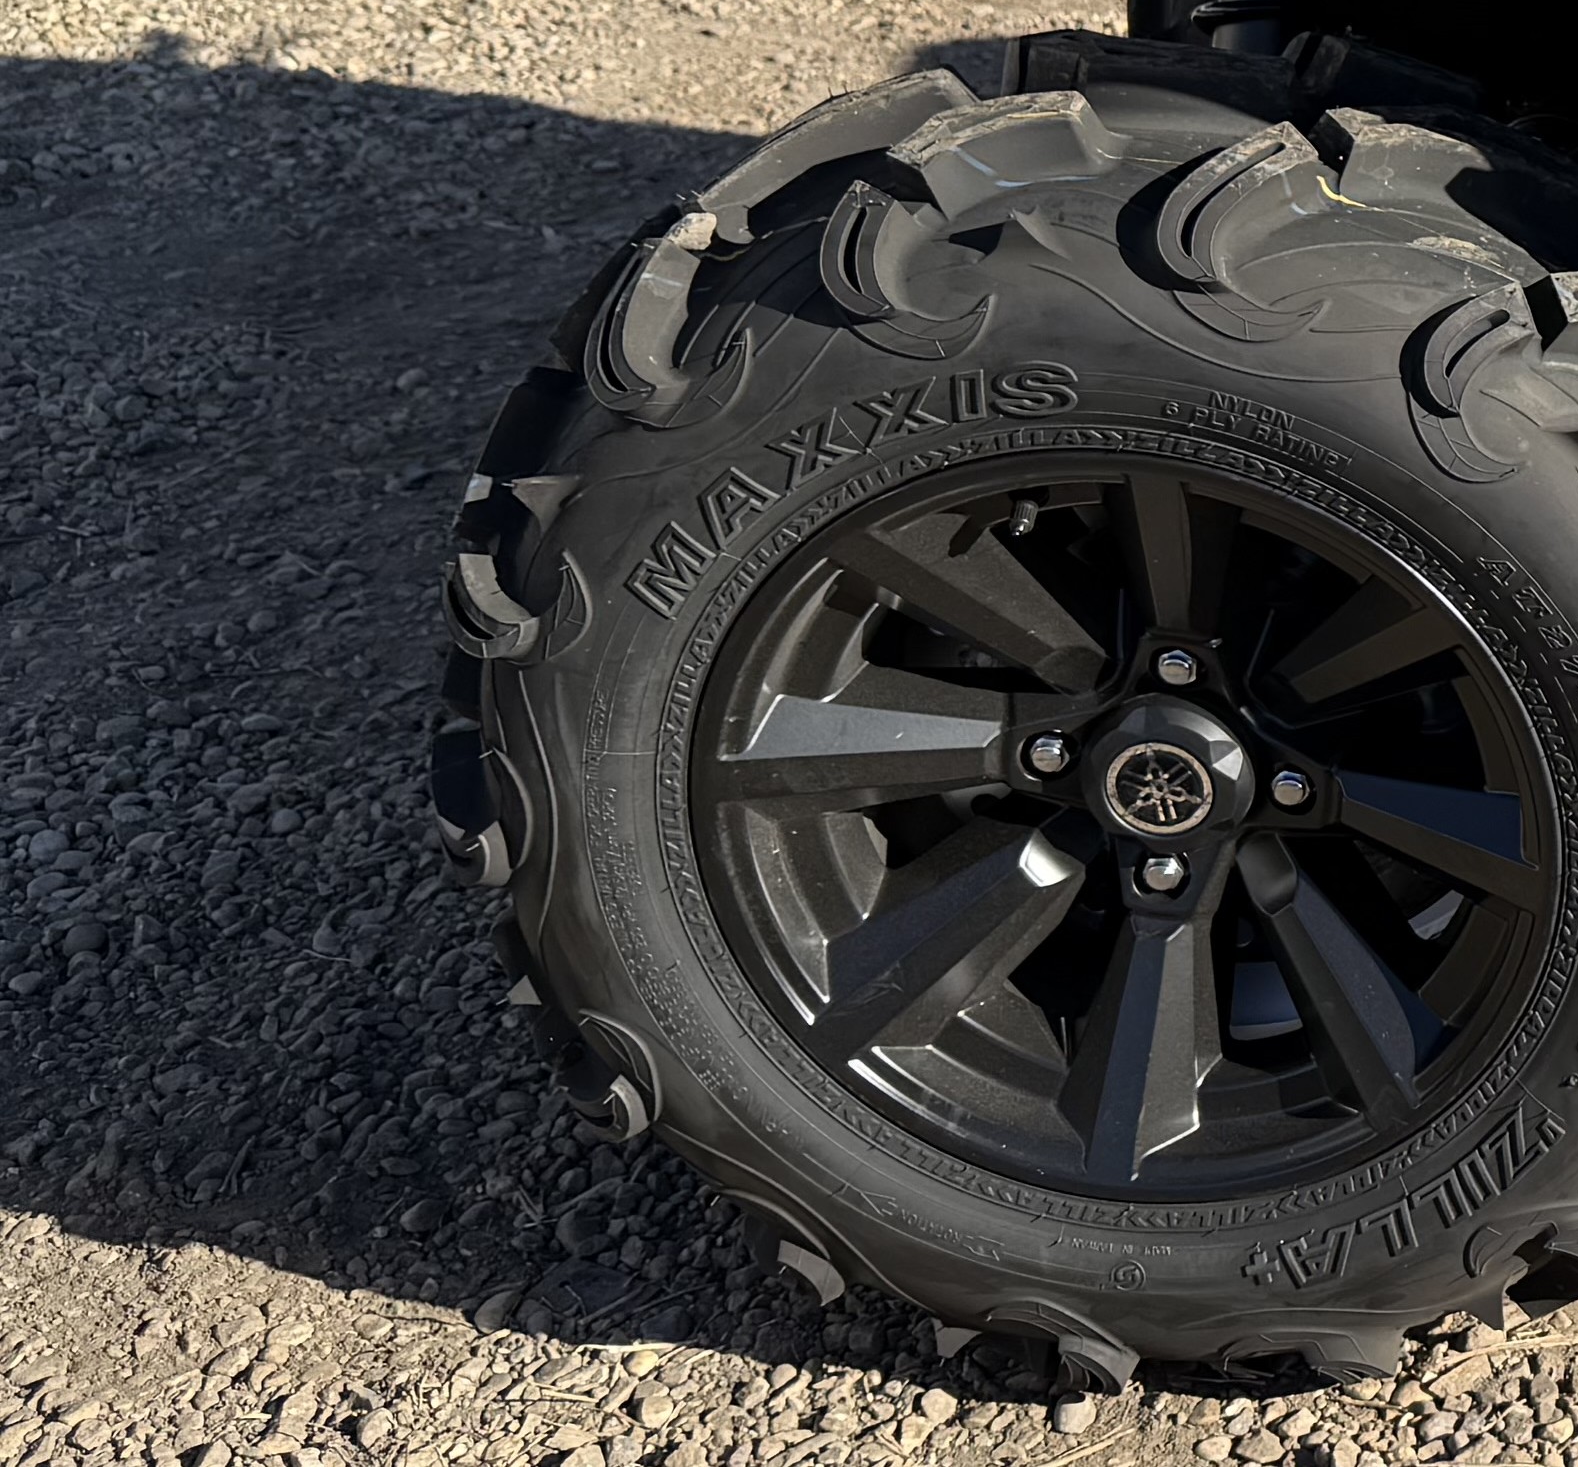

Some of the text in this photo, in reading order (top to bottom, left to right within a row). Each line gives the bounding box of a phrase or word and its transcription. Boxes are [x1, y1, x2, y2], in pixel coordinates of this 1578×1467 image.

[1194, 403, 1245, 434] PLY
[1254, 424, 1342, 470] RATING
[1208, 390, 1296, 430] NYLON
[622, 359, 1079, 621] MAXXIS
